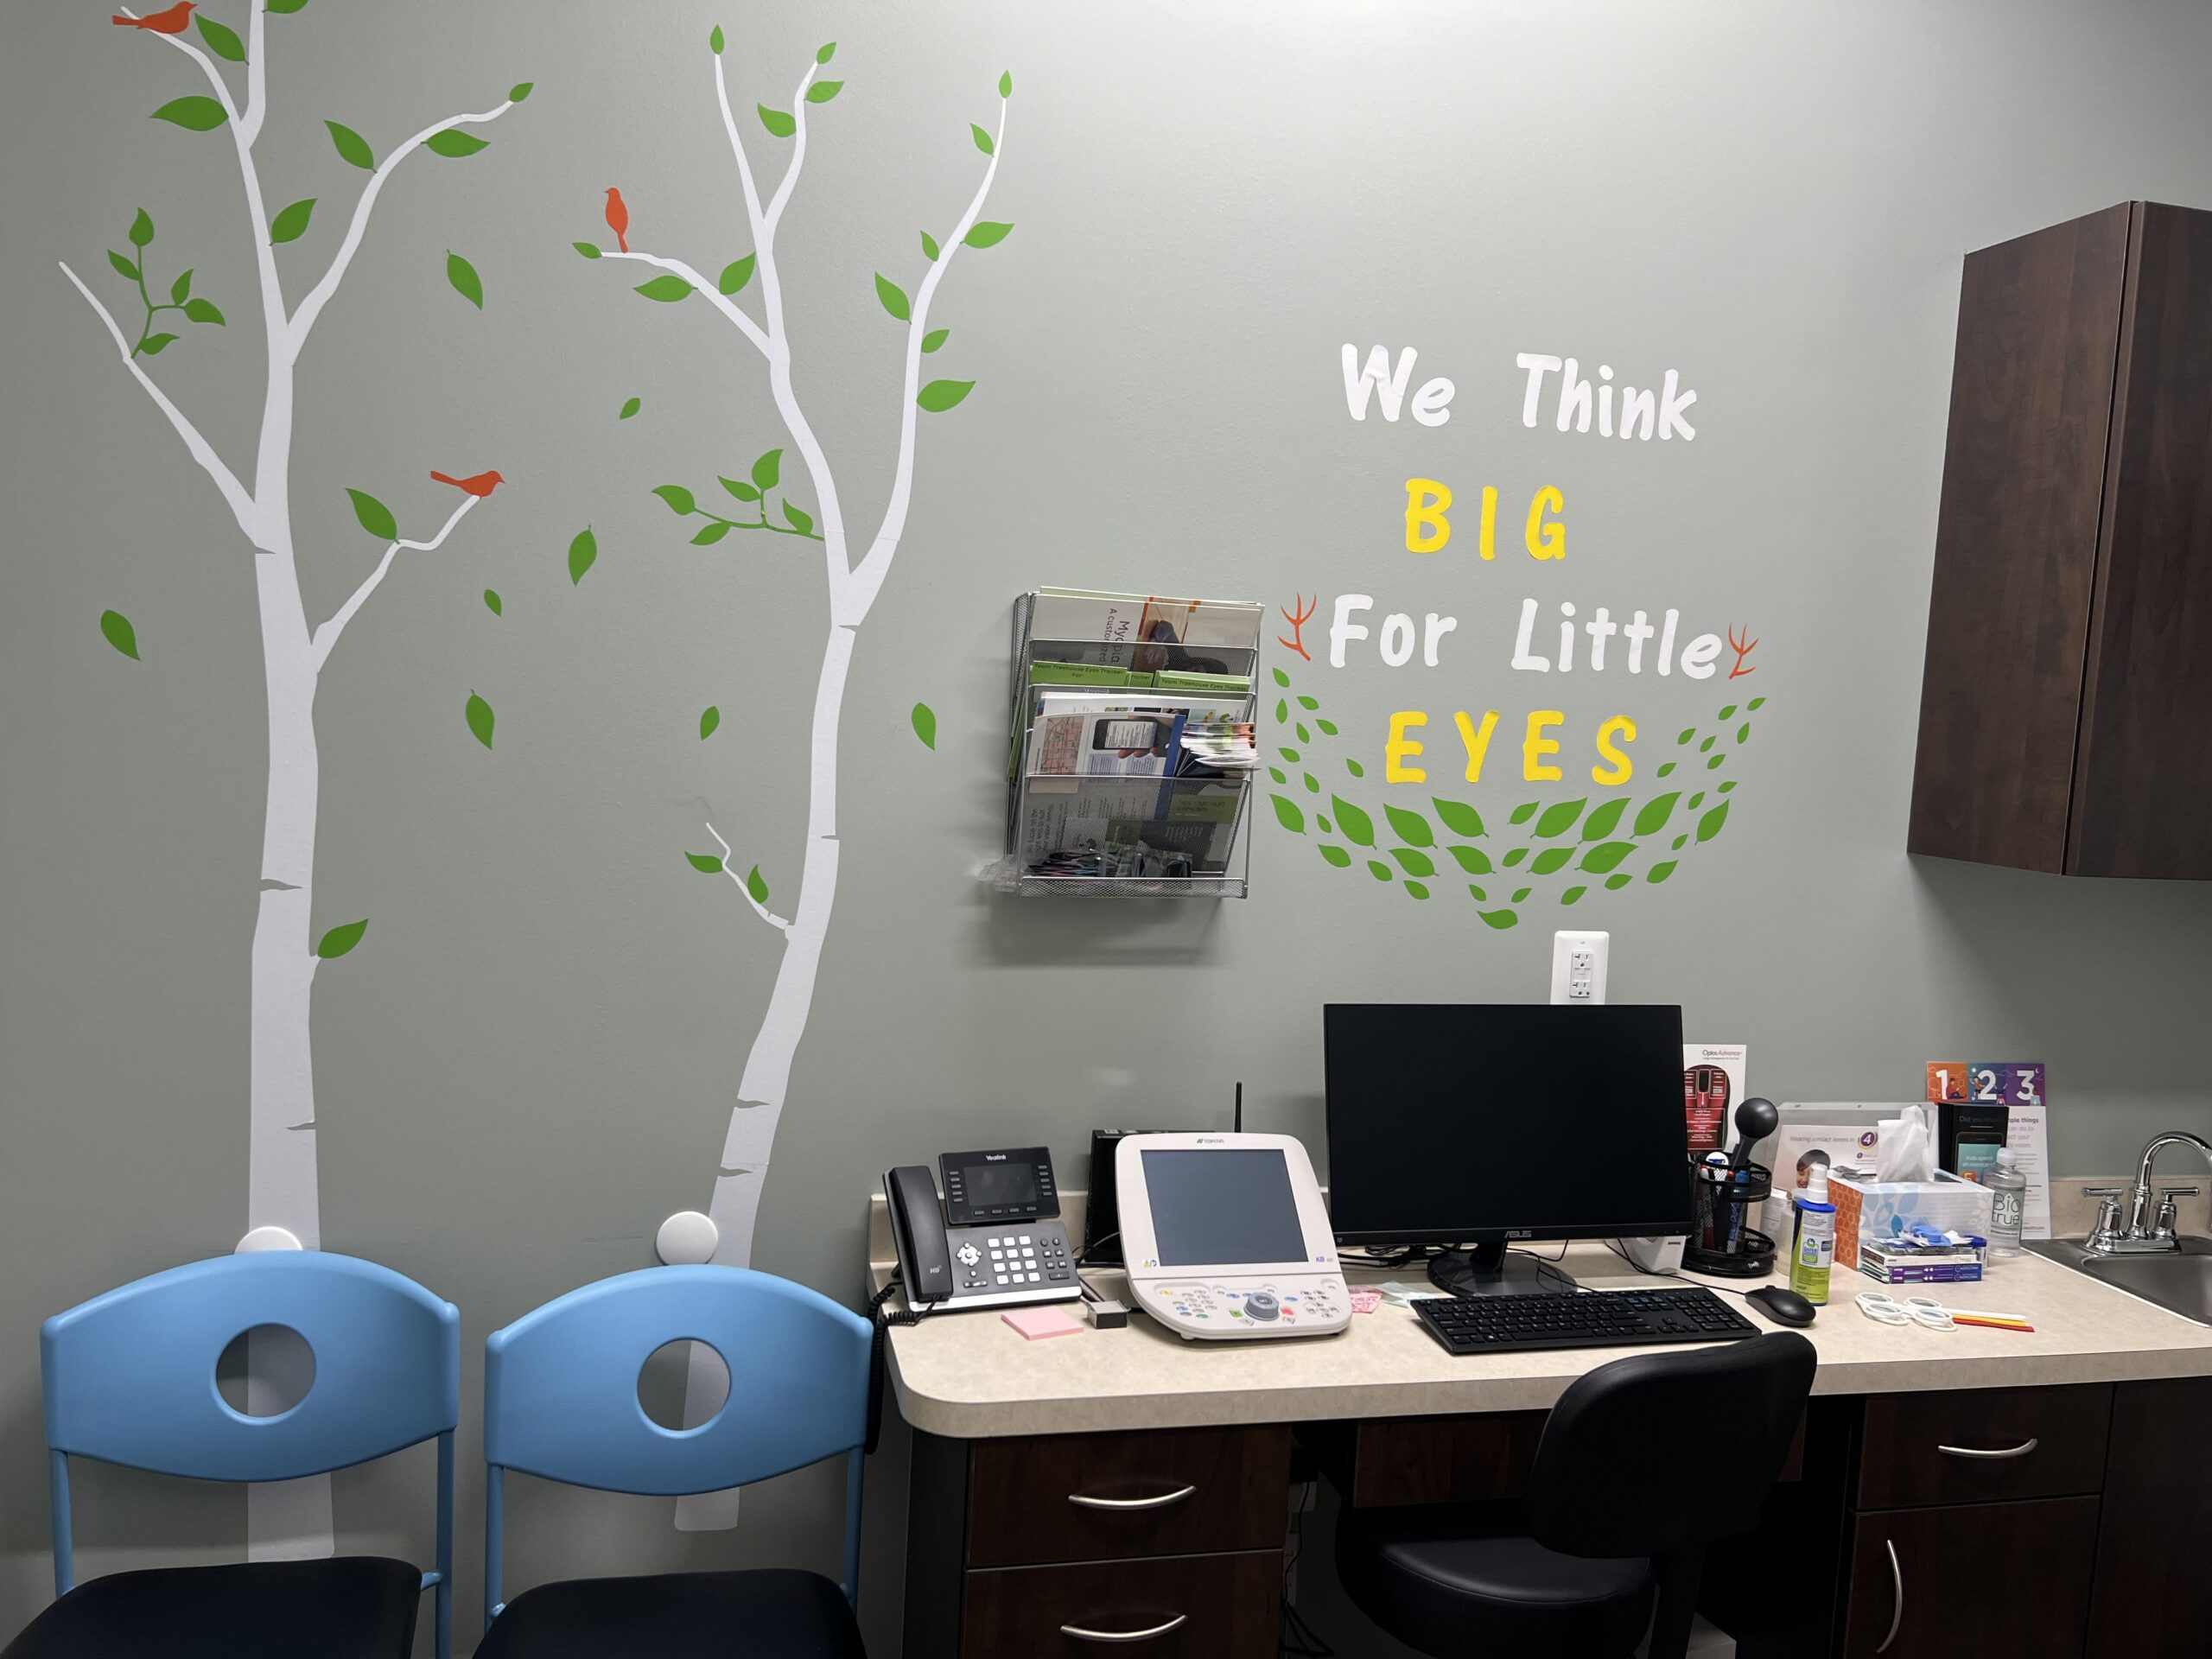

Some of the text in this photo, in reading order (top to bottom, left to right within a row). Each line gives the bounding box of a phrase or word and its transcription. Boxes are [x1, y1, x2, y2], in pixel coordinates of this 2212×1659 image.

[1342, 343, 1697, 442] We Think
[1405, 478, 1566, 561] BIG
[1330, 594, 1723, 679] For Little
[1385, 710, 1637, 786] EYES
[1936, 1070, 2035, 1100] 1 2 3
[1992, 1211, 2020, 1224] true
[1993, 1192, 2021, 1212] Bio
